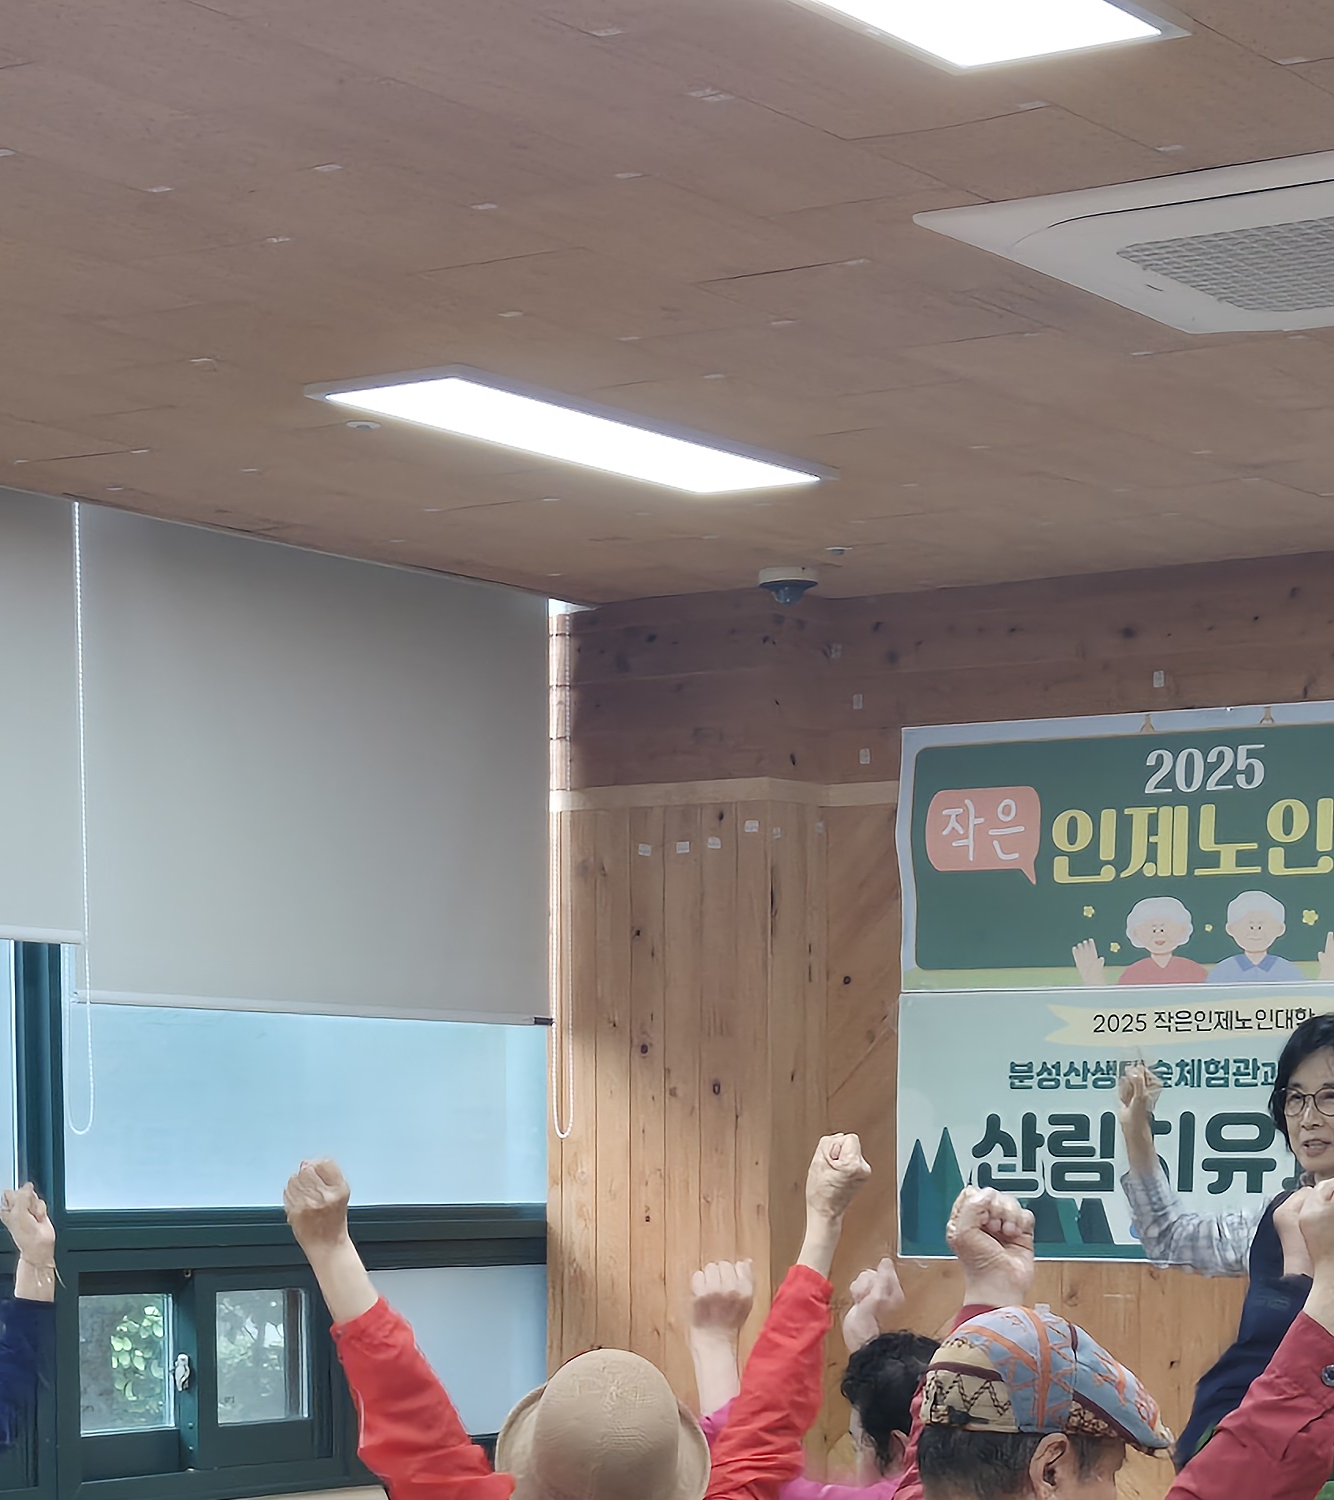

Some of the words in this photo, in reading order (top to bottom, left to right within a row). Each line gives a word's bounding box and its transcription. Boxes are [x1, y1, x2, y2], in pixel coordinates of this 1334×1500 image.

[1144, 744, 1266, 794] 2025
[942, 798, 1025, 861] 작은
[1093, 1013, 1147, 1033] 2025
